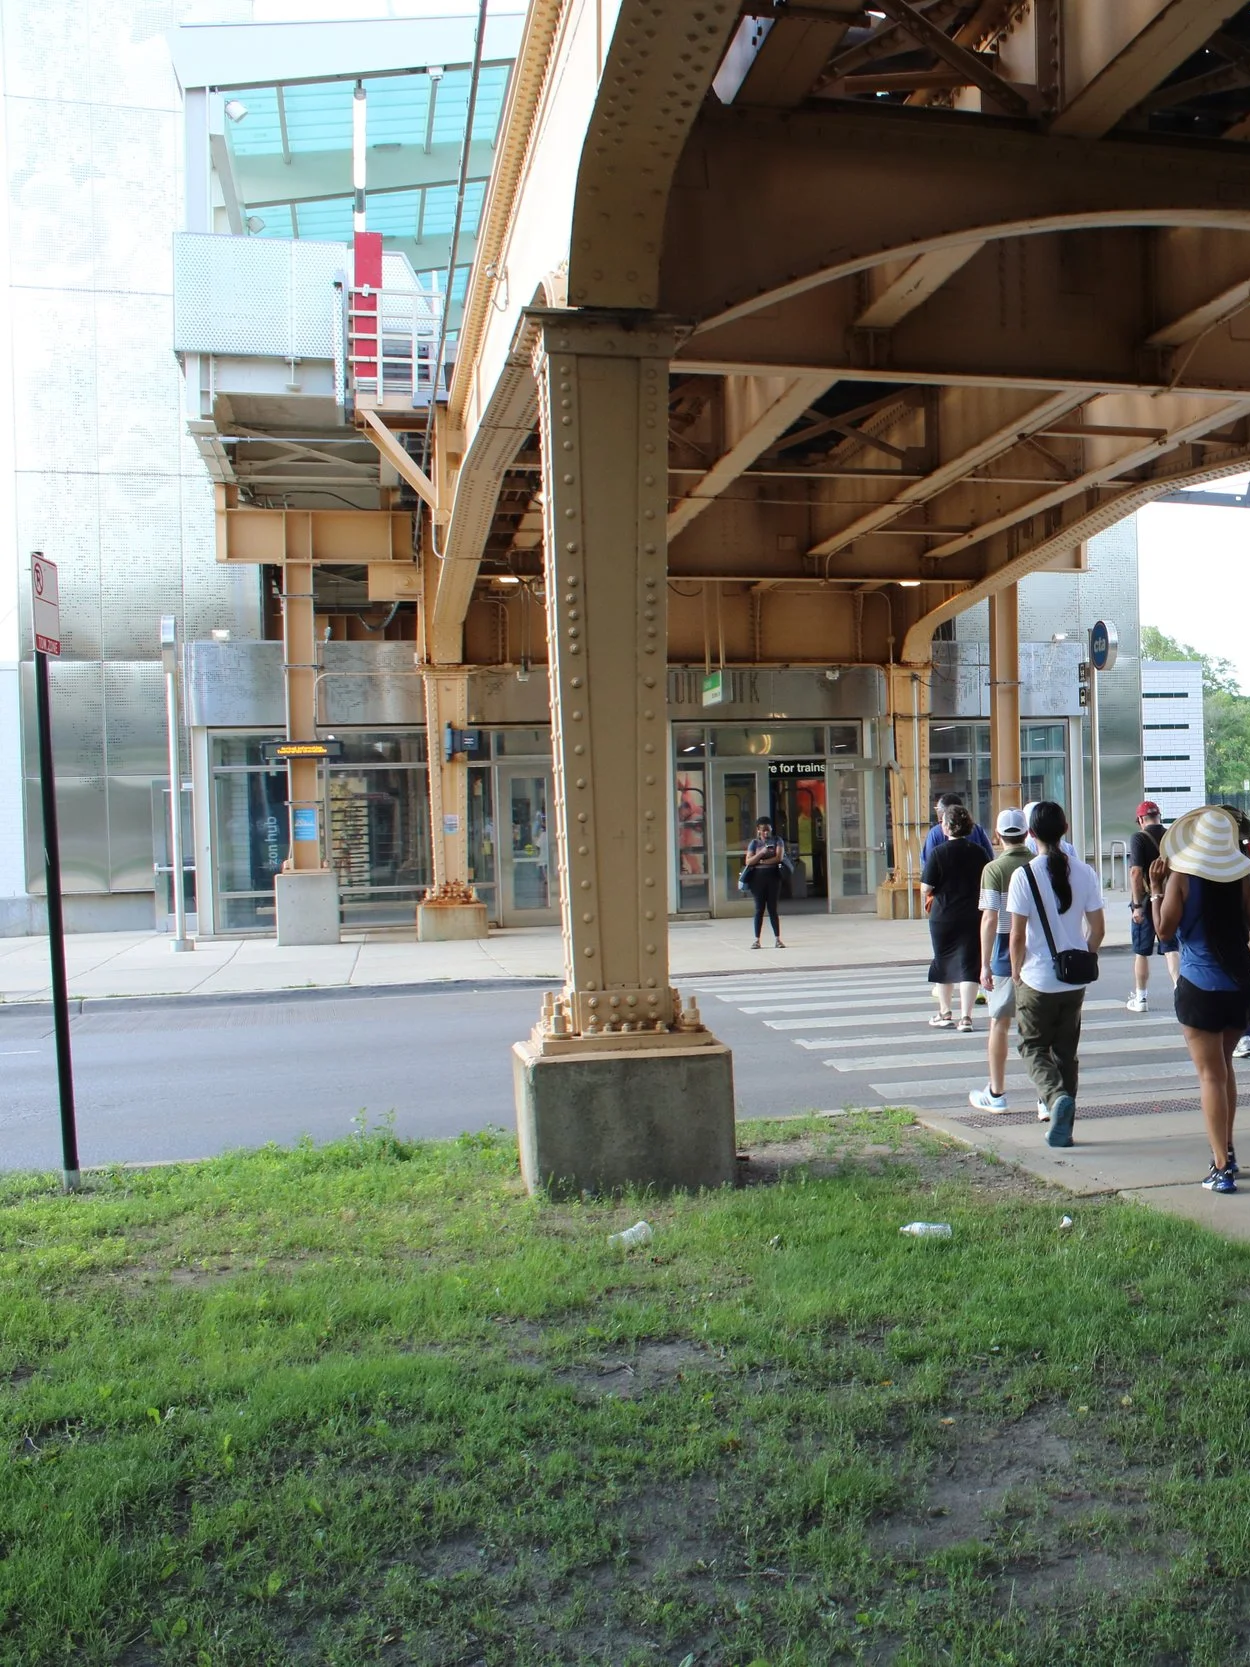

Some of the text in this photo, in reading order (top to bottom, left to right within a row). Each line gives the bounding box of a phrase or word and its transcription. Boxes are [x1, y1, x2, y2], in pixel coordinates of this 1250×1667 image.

[47, 640, 59, 654] ZONE
[1094, 637, 1106, 653] cta
[780, 763, 794, 773] for
[797, 762, 825, 772] trains
[264, 816, 278, 842] hub
